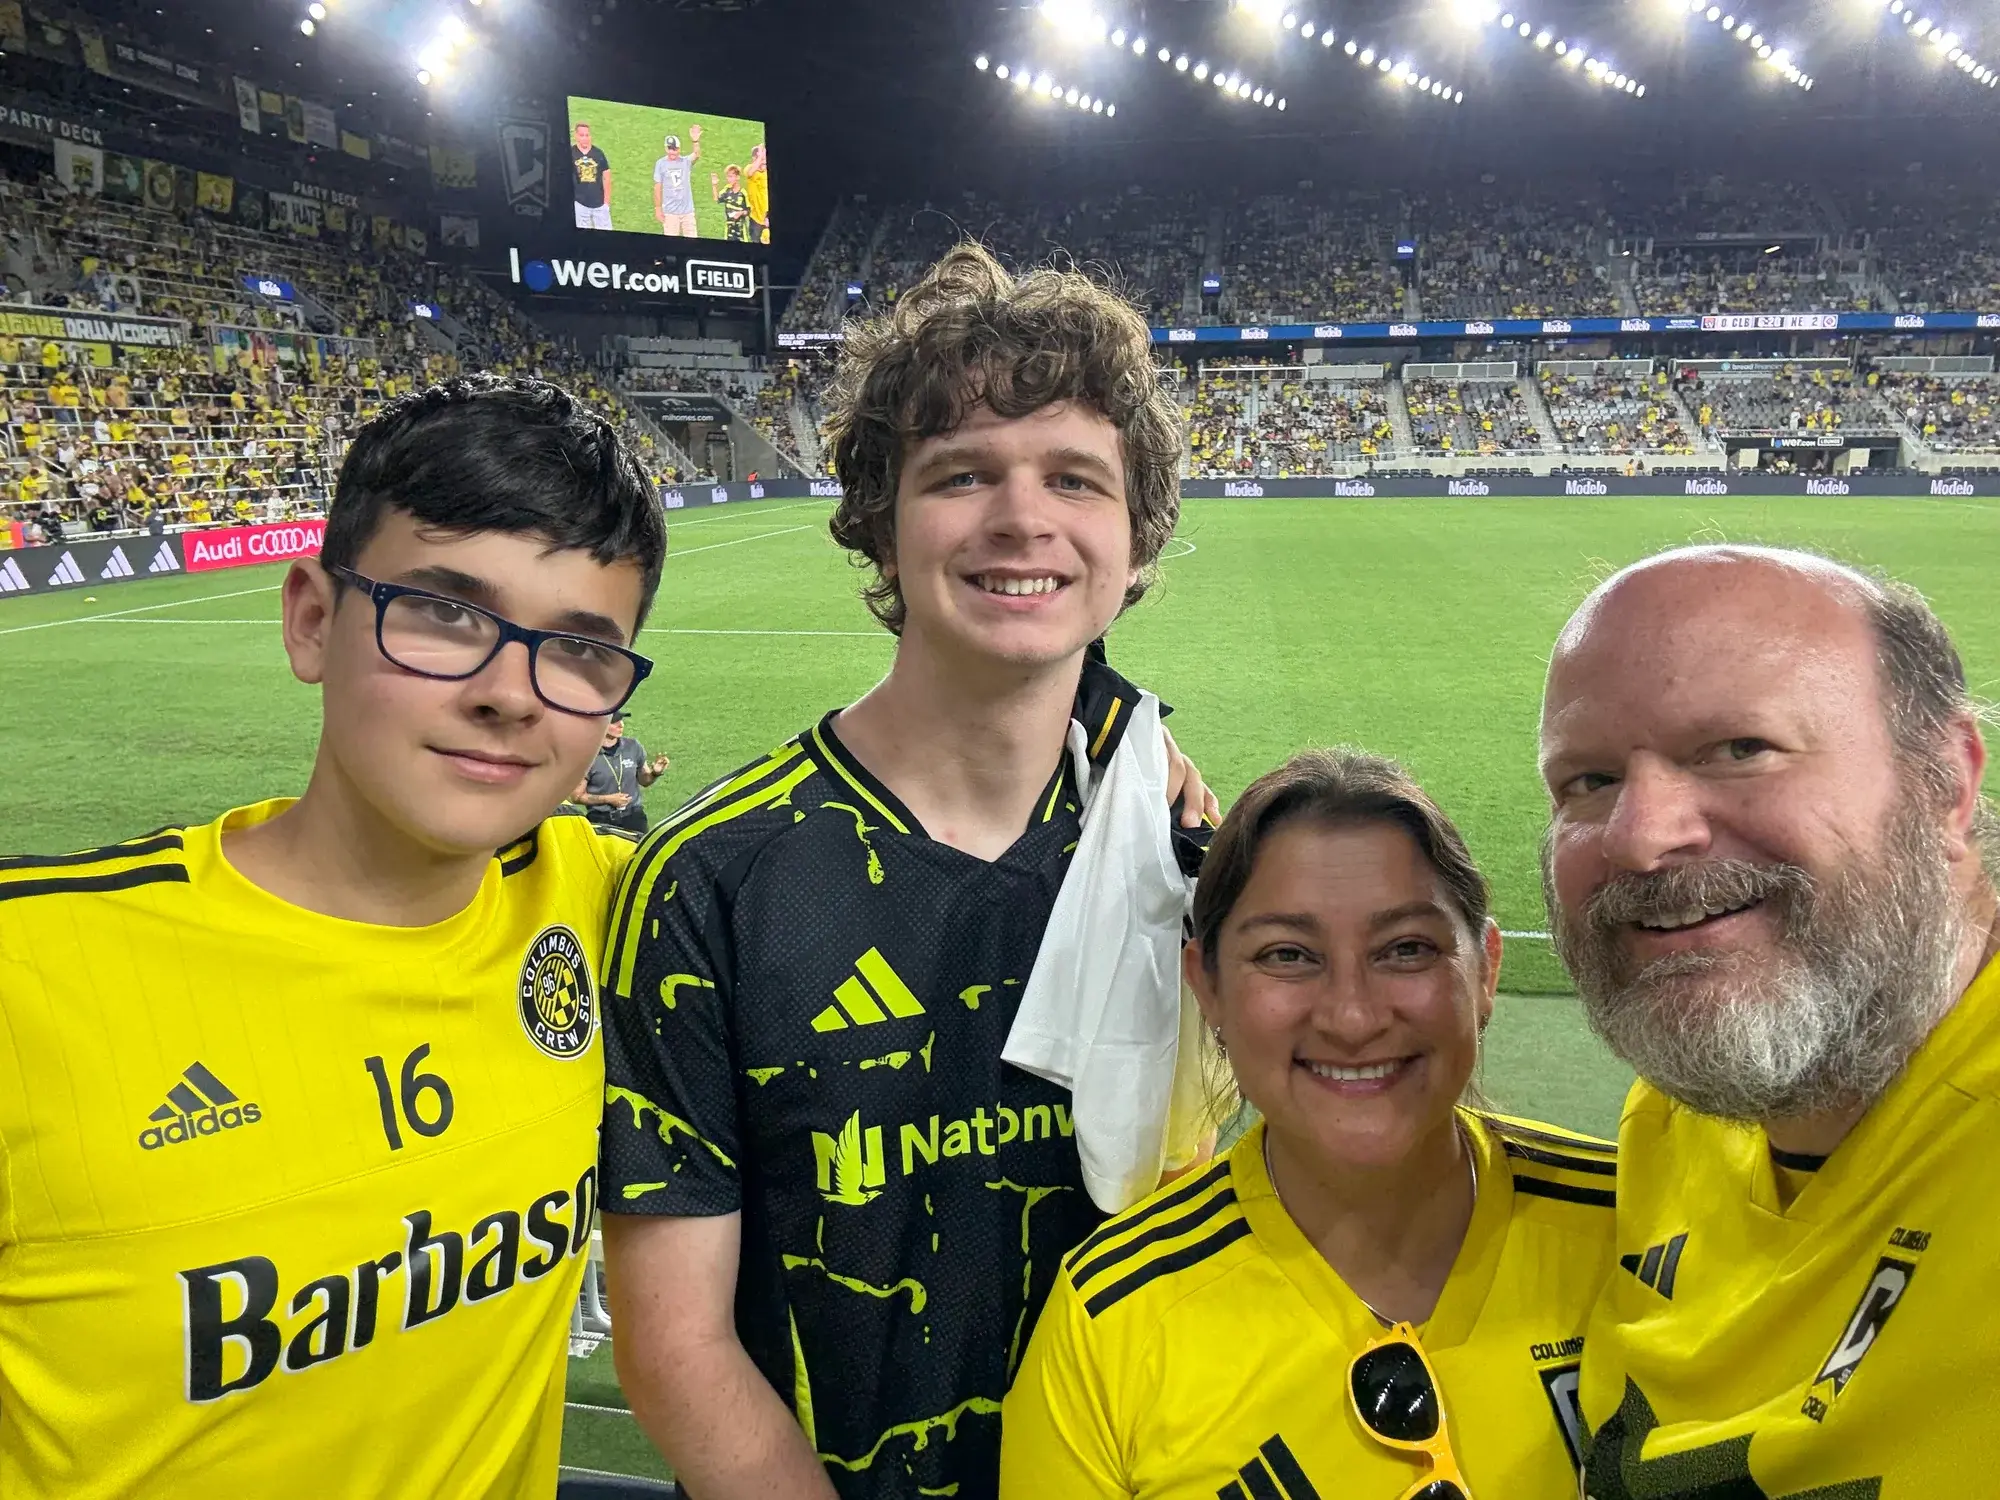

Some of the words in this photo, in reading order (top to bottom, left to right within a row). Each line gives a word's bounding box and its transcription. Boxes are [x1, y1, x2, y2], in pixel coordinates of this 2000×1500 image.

[0, 105, 52, 133] PARTY
[60, 121, 104, 146] DECK
[697, 269, 744, 289] FIELD
[1465, 322, 1494, 335] Modelo
[1542, 321, 1572, 333] Modelo
[1620, 319, 1650, 332] Modelo
[1732, 317, 1751, 328] CLB
[1812, 316, 1819, 327] 2
[1894, 315, 1925, 328] Modelo
[1314, 327, 1343, 339] Modelo
[1389, 325, 1418, 337] Modelo
[1225, 482, 1264, 497] Modelo
[1335, 482, 1374, 497] Modelo
[1448, 480, 1489, 496] Modelo
[1565, 481, 1607, 496] Modelo
[1685, 480, 1727, 495] Modelo
[1806, 480, 1848, 495] Modelo
[1930, 479, 1973, 495] Modelo
[193, 536, 242, 563] Audi
[523, 934, 581, 998] COLUMBUS
[542, 972, 556, 996] 96
[579, 993, 590, 1024] SC
[534, 1021, 580, 1051] CREW
[363, 1043, 455, 1151] 16
[138, 1102, 262, 1151] adidas
